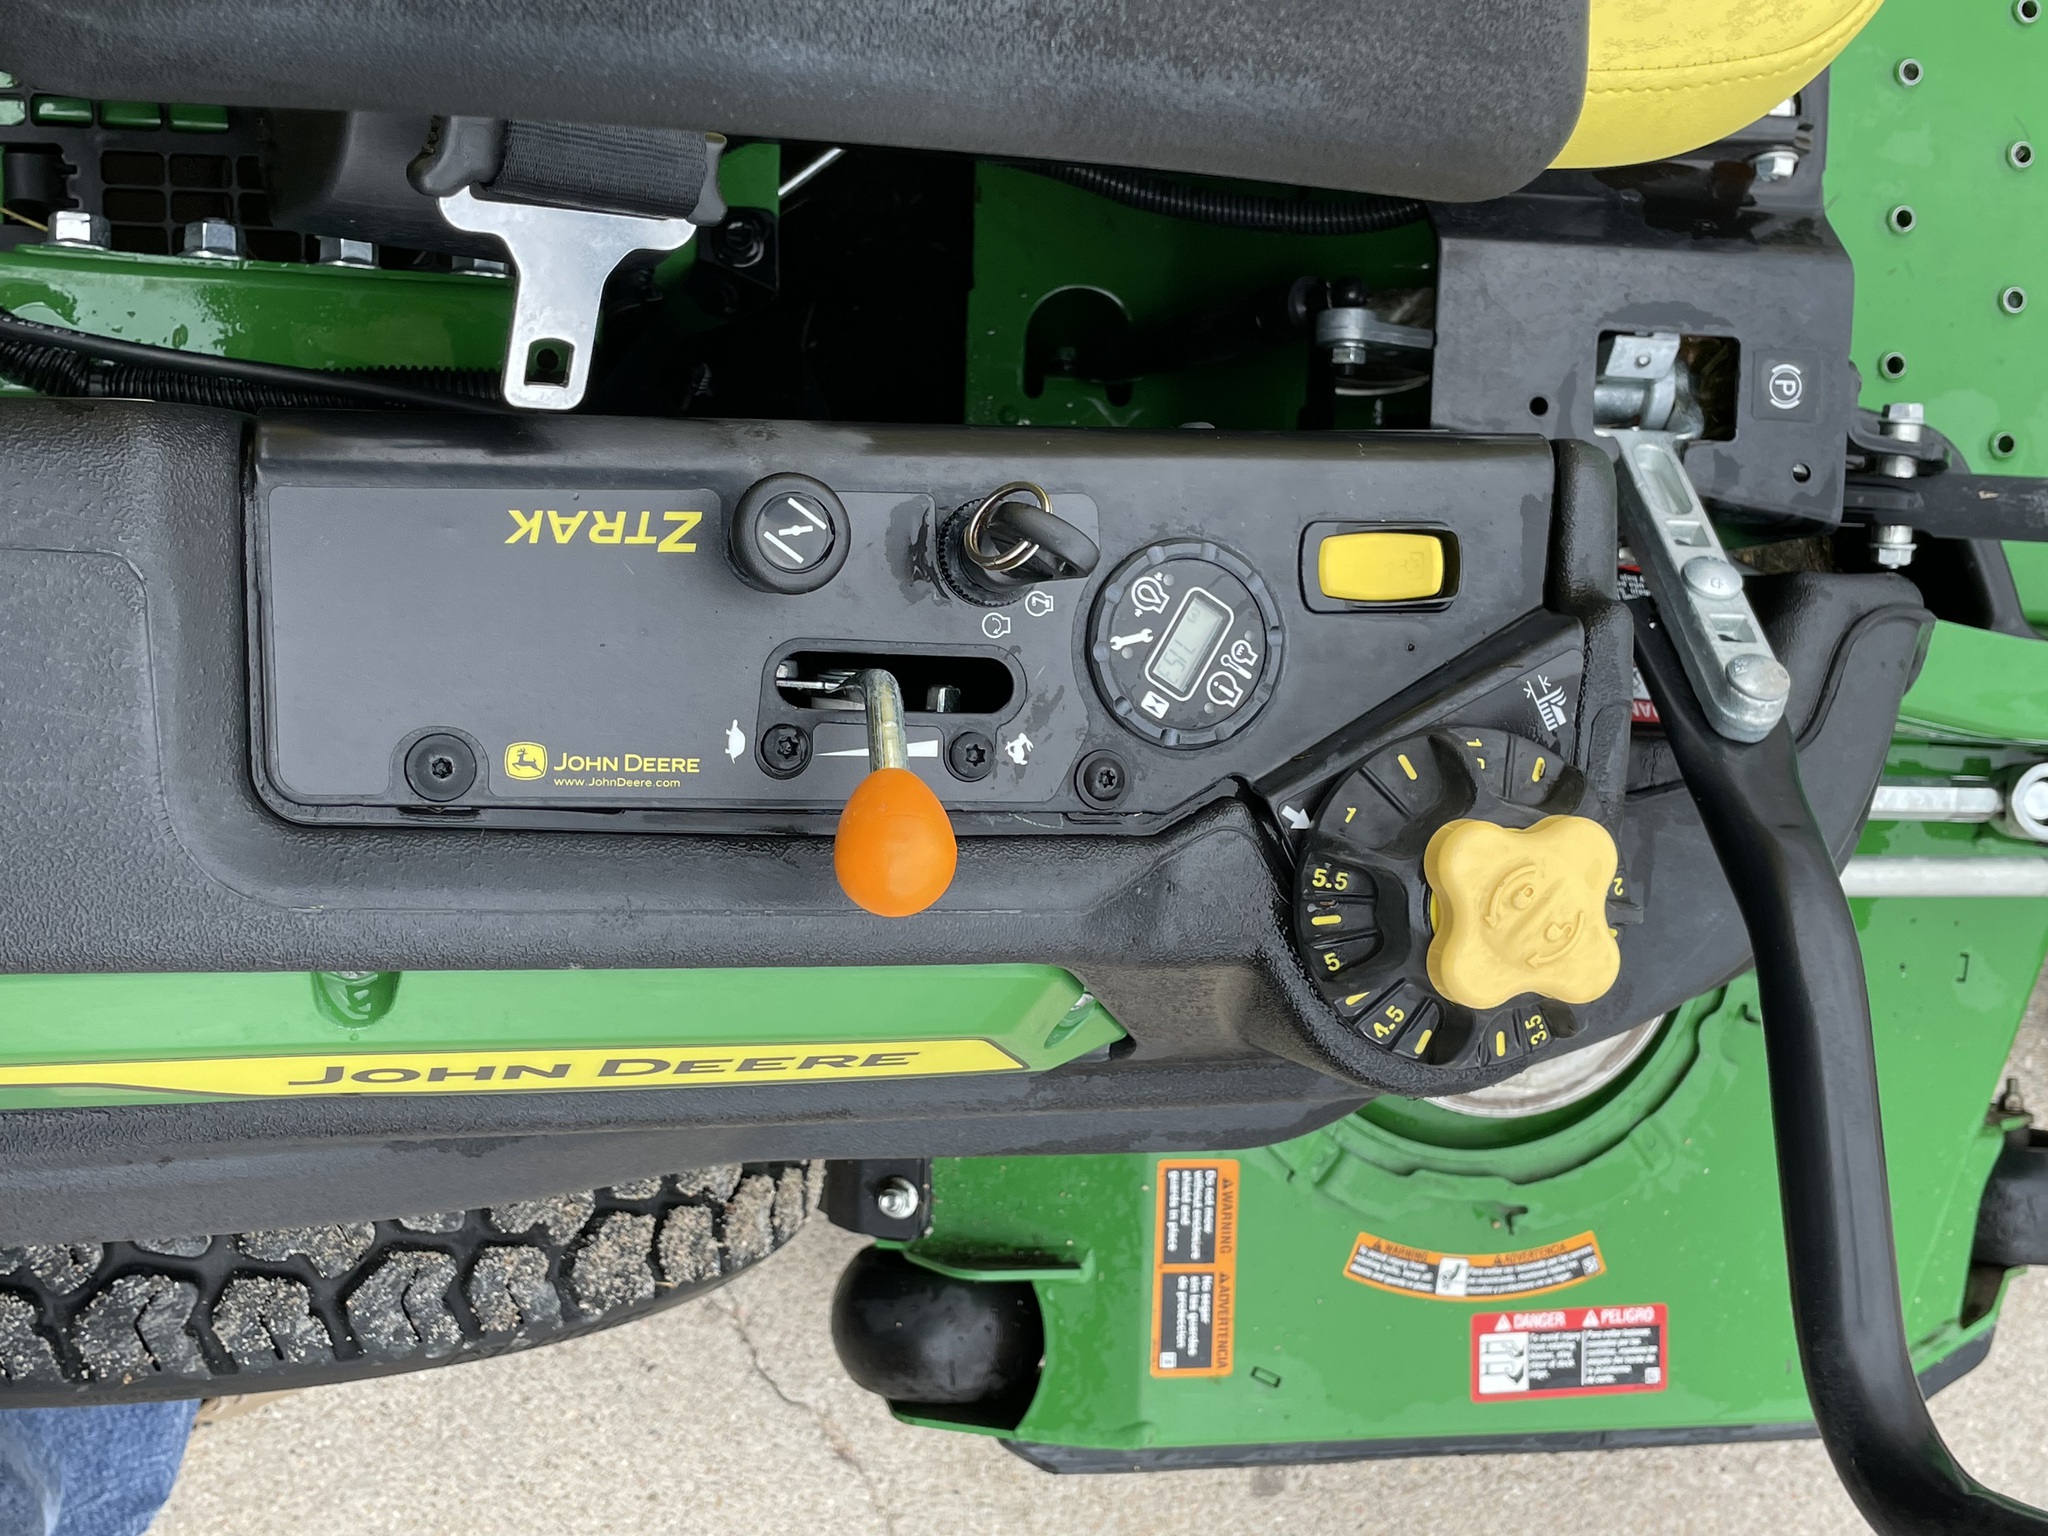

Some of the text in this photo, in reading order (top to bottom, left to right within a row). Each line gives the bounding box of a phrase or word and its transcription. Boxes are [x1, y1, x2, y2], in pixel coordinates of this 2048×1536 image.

[504, 510, 703, 553] ZTRAK
[554, 752, 700, 773] JOHN DEERE
[554, 777, 681, 788] www.JohnDeere.com
[1312, 868, 1349, 891] 5.5
[1324, 952, 1341, 972] 5
[1373, 1005, 1405, 1038] 4.5
[1524, 1014, 1547, 1046] 3.5
[288, 1051, 921, 1086] JOHN DEERE
[1219, 1191, 1234, 1254] WARNING
[1216, 1288, 1230, 1369] ADVERTENCIA
[1513, 1311, 1566, 1329] DANGER
[1600, 1306, 1655, 1325] PELIGRO
